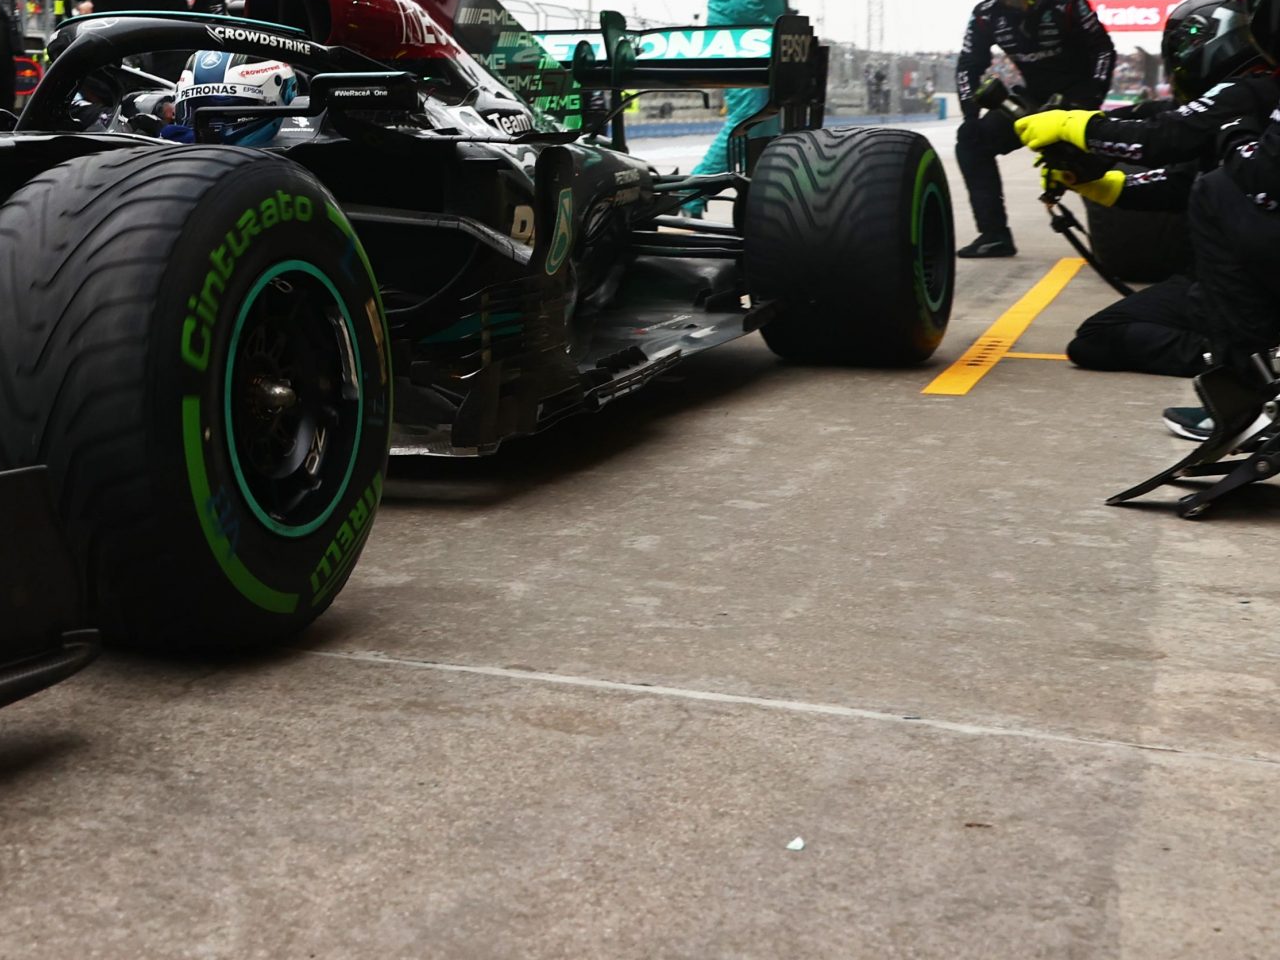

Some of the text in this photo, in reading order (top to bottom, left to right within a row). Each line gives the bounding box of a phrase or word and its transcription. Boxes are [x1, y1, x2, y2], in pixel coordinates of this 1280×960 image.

[1096, 3, 1161, 26] irates
[214, 26, 312, 55] CROWDSTRIKE
[180, 85, 237, 98] PETRONAS
[243, 86, 263, 96] EPSON
[181, 190, 314, 372] Cinturato
